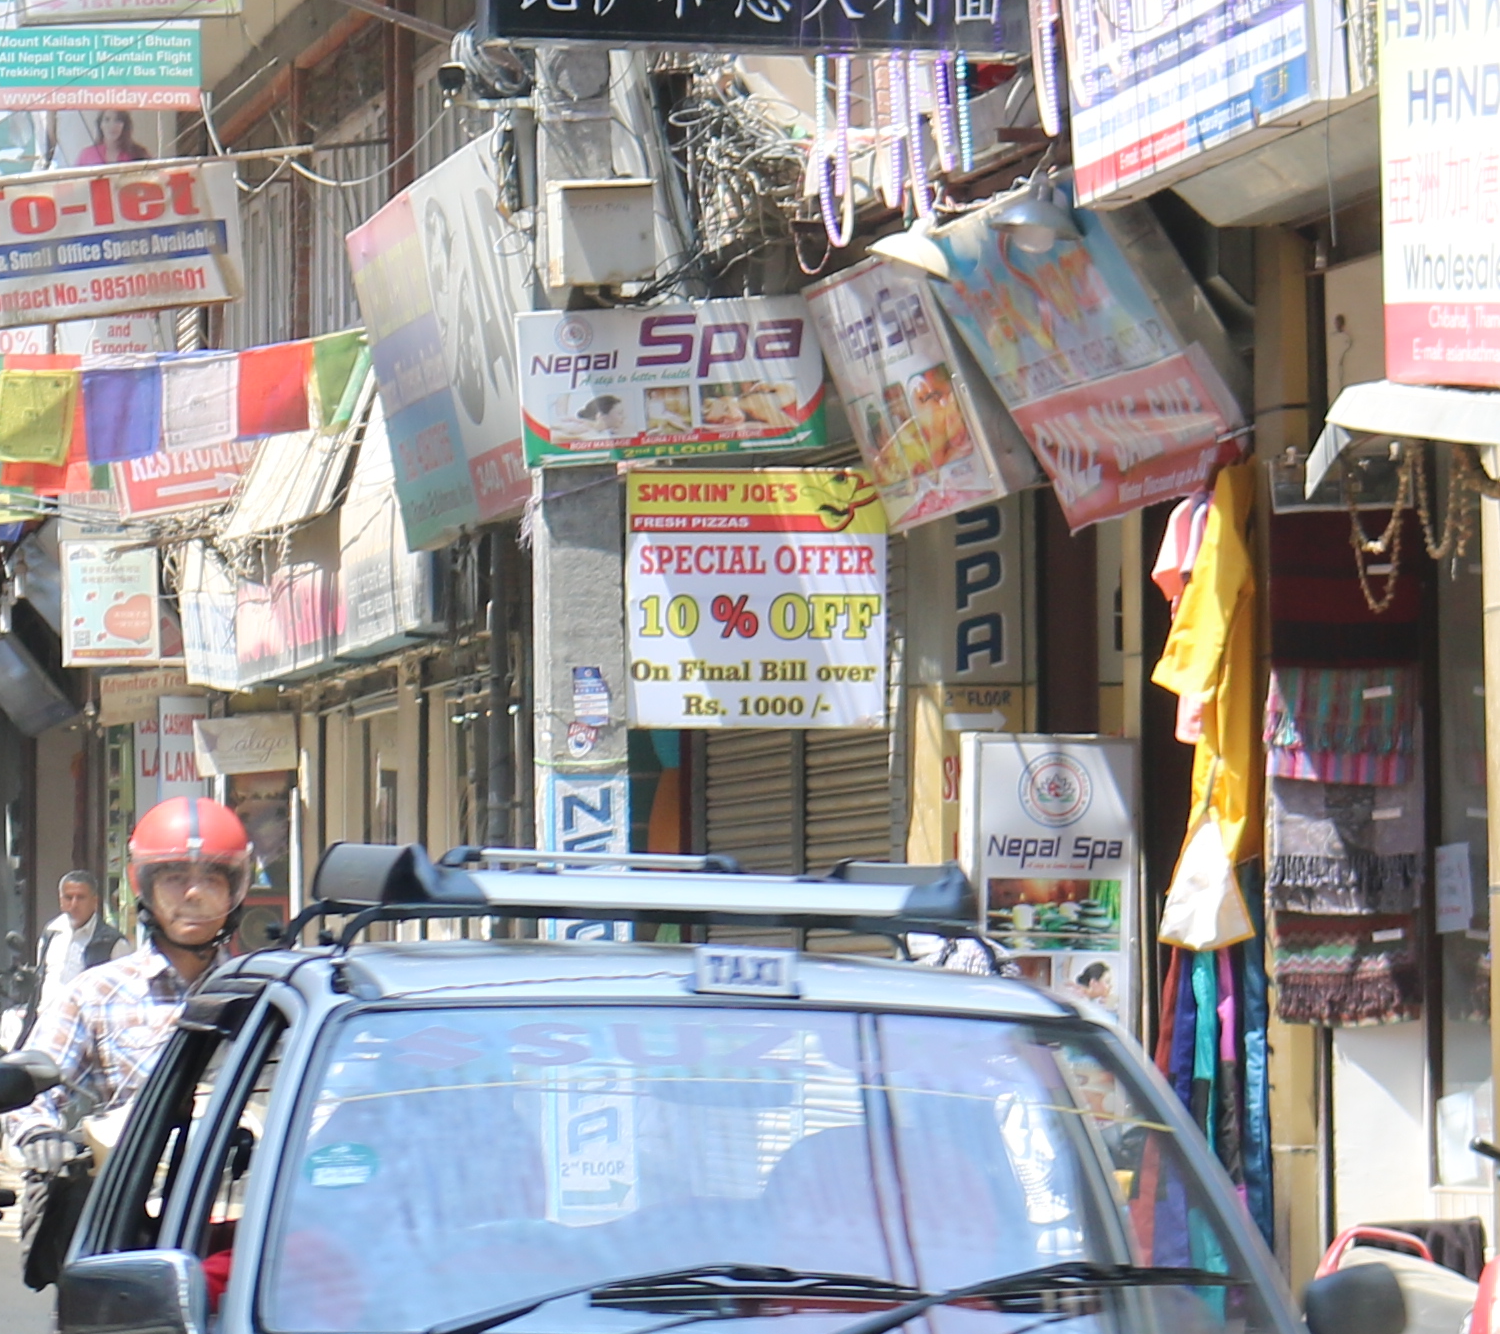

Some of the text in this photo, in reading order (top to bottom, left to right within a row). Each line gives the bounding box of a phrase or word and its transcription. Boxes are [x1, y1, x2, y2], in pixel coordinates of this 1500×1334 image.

[43, 36, 90, 47] Kailash
[102, 36, 134, 47] Tibet
[146, 36, 191, 47] Bhutan
[0, 50, 192, 64] All Nepal Tour Mountain Flight
[0, 66, 193, 79] Trekking Rafting Air Bus Ticket
[3, 87, 191, 108] www.leafholiday.com
[10, 248, 51, 271] Small
[57, 246, 99, 264] Office
[103, 242, 148, 262] Space
[152, 230, 217, 252] Available
[107, 324, 130, 338] and
[531, 314, 802, 388] Nepal Spa
[623, 441, 728, 458] 2nd FLOOR
[637, 482, 797, 503] SMOKIN' JOE'S
[634, 517, 749, 529] FRESH PIZZAS
[640, 543, 876, 575] SPECIAL OFFER
[639, 593, 881, 638] 10 % OFF
[631, 659, 876, 683] On Final Bill over
[683, 695, 830, 717] Rs. 1000 /-
[968, 691, 1012, 706] FLOOR
[988, 836, 1123, 869] Nepal Spa
